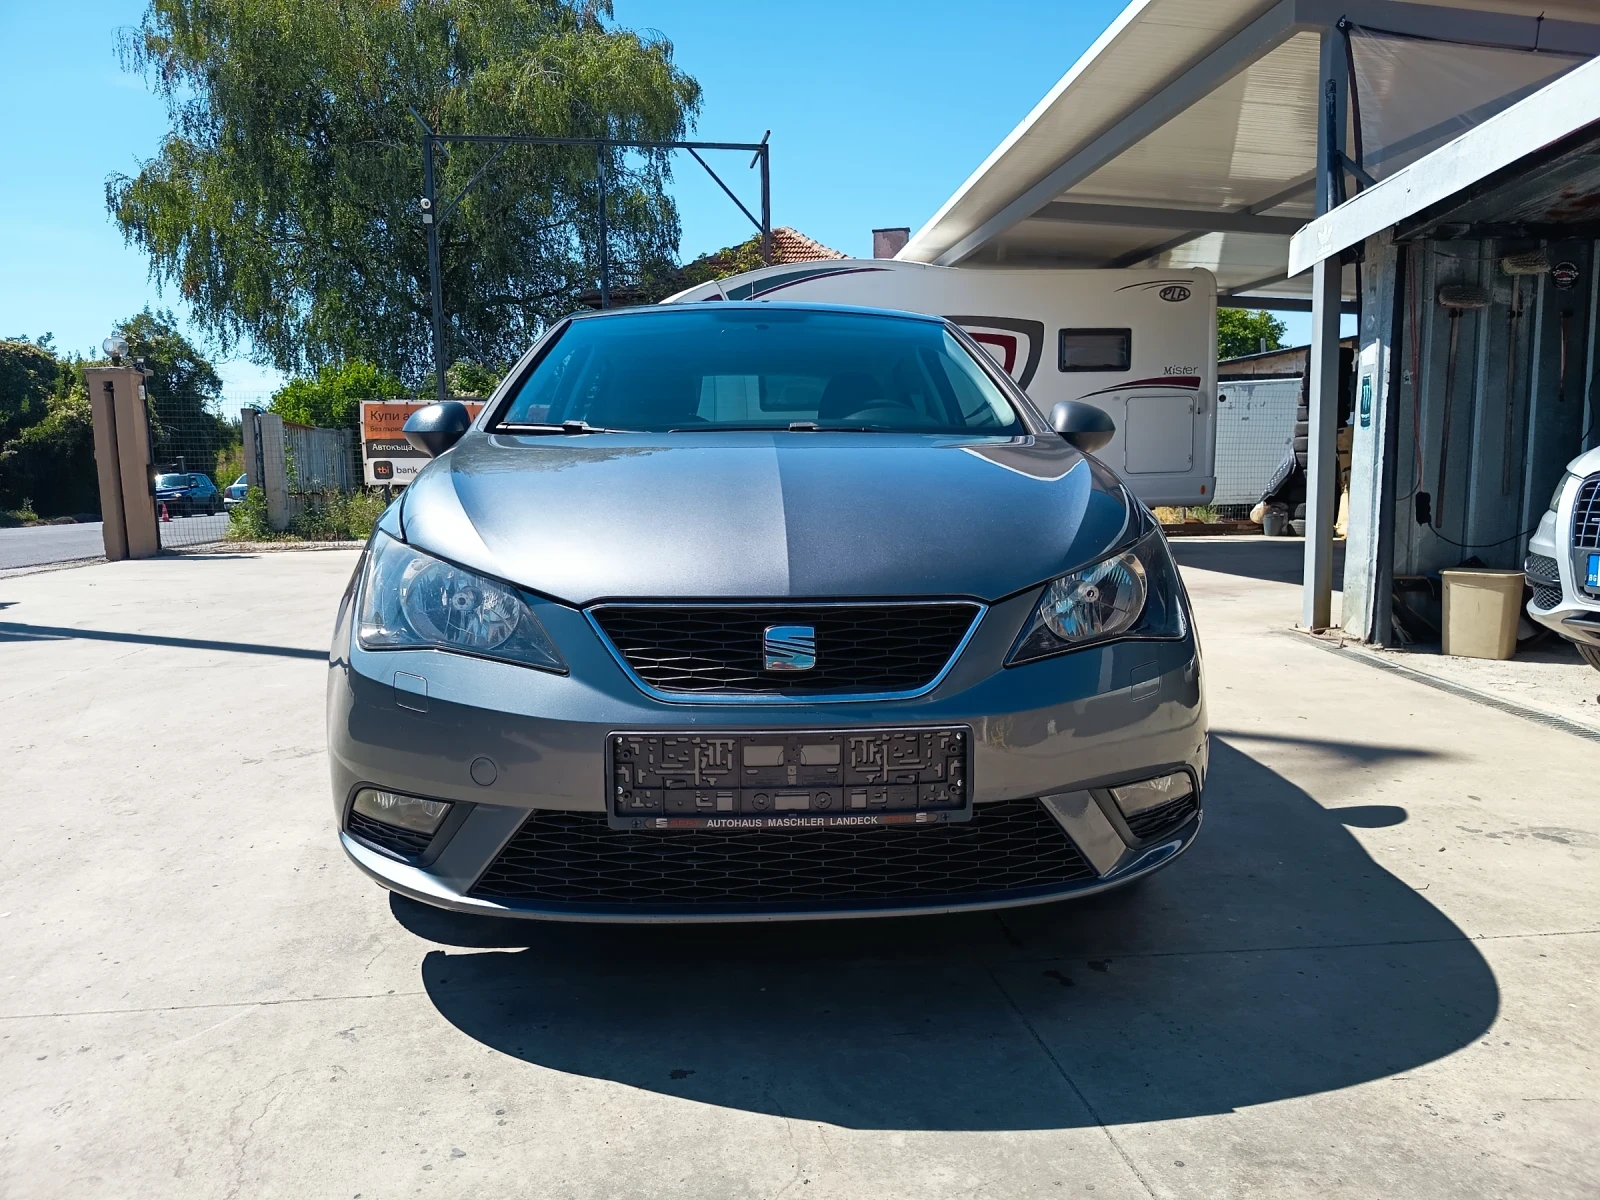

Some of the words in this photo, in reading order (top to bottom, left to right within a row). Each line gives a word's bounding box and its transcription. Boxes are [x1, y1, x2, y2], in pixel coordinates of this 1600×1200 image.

[1162, 288, 1188, 299] PLA
[1163, 364, 1199, 375] Mister
[370, 410, 400, 422] Купи
[372, 443, 413, 452] Автокъща
[377, 466, 390, 474] tbi
[396, 466, 418, 474] bank
[1588, 574, 1597, 582] BG
[706, 818, 763, 828] AUTOHAUS
[767, 817, 825, 827] MASCHLER
[829, 815, 878, 826] LANDECK
